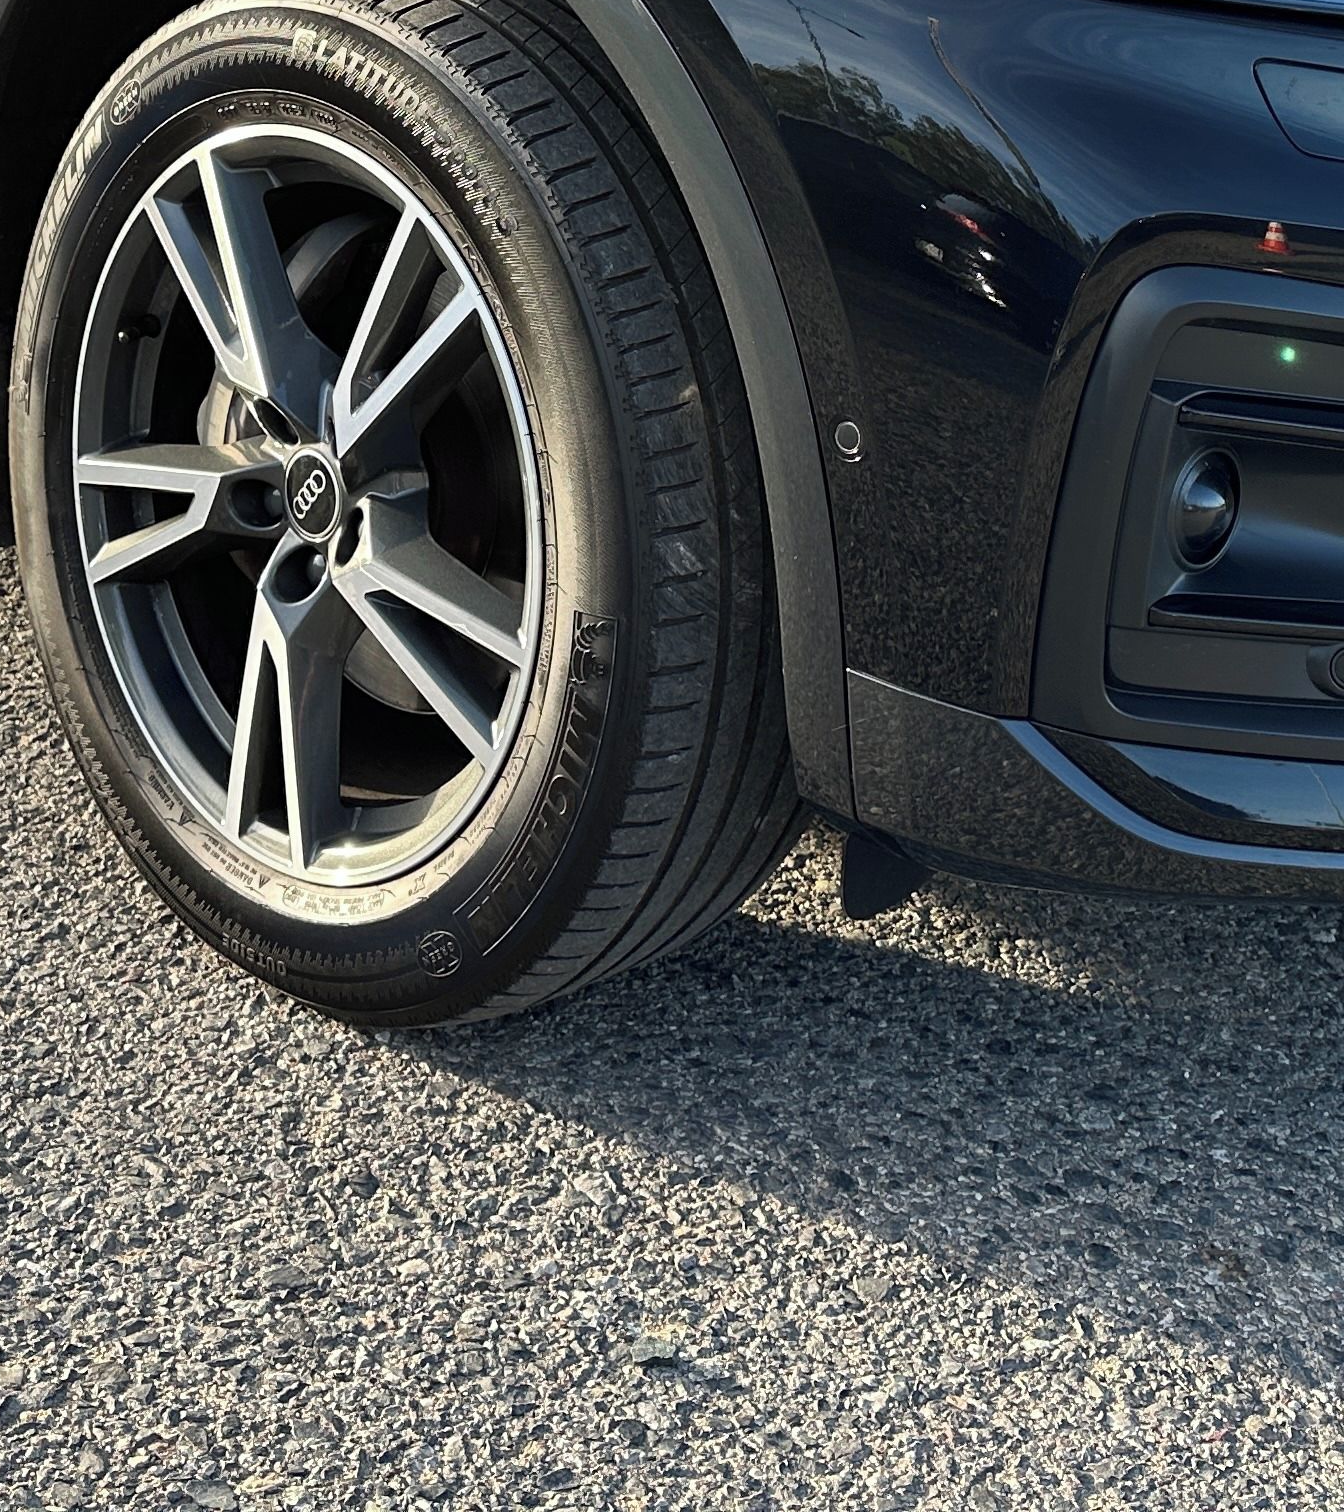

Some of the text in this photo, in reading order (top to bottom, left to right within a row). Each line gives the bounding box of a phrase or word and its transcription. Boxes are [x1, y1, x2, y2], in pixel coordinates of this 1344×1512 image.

[315, 39, 432, 120] LATITUDE
[18, 113, 104, 344] MICHELIN
[221, 932, 288, 977] OUTSIDE
